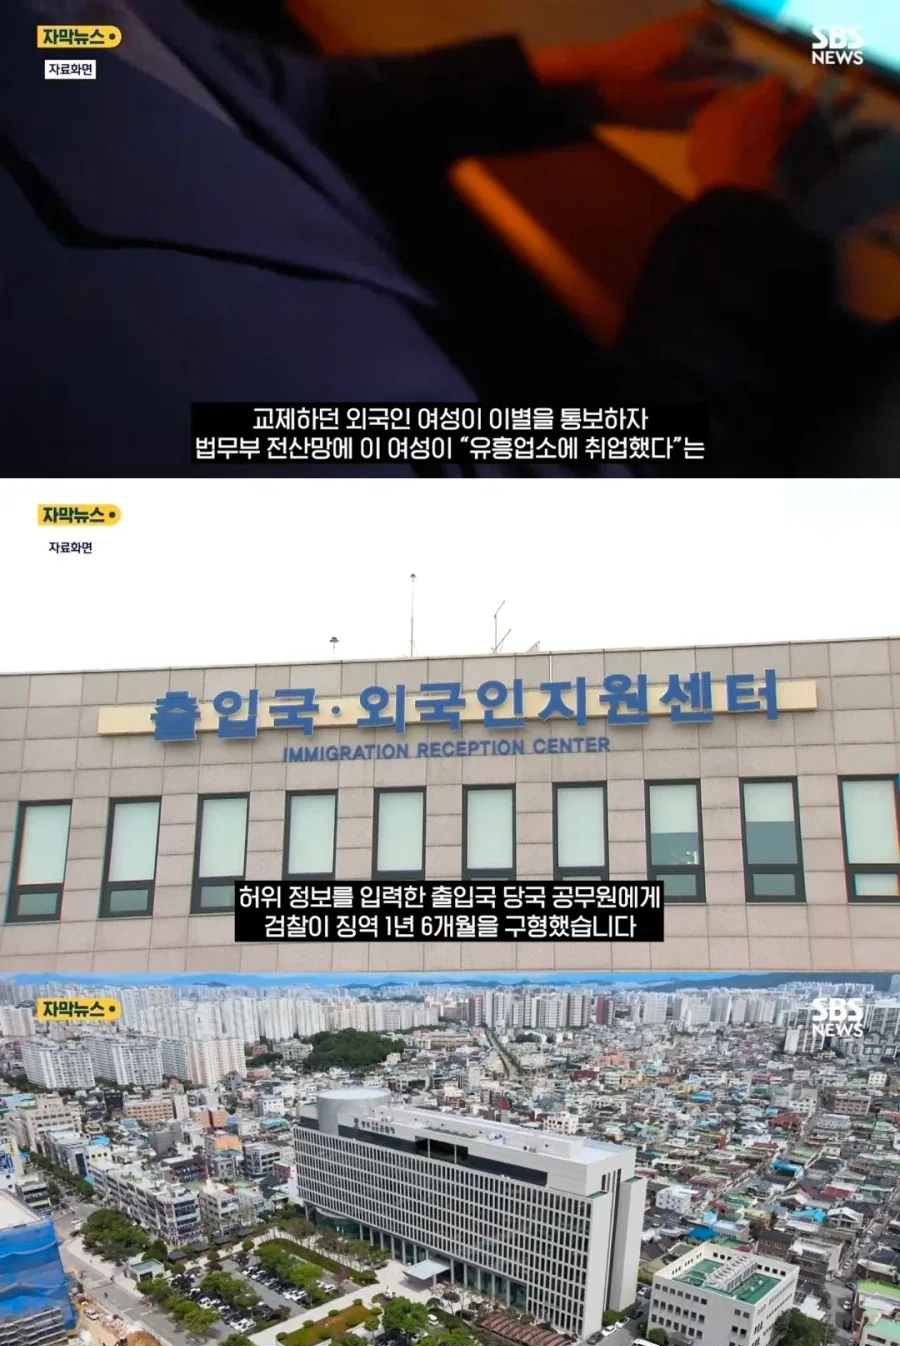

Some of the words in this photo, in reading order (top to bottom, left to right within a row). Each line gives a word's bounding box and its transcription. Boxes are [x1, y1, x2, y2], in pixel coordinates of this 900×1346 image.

[282, 742, 409, 763] IMMIGRATION
[417, 739, 525, 758] RECEPTION
[533, 736, 611, 755] CENTER
